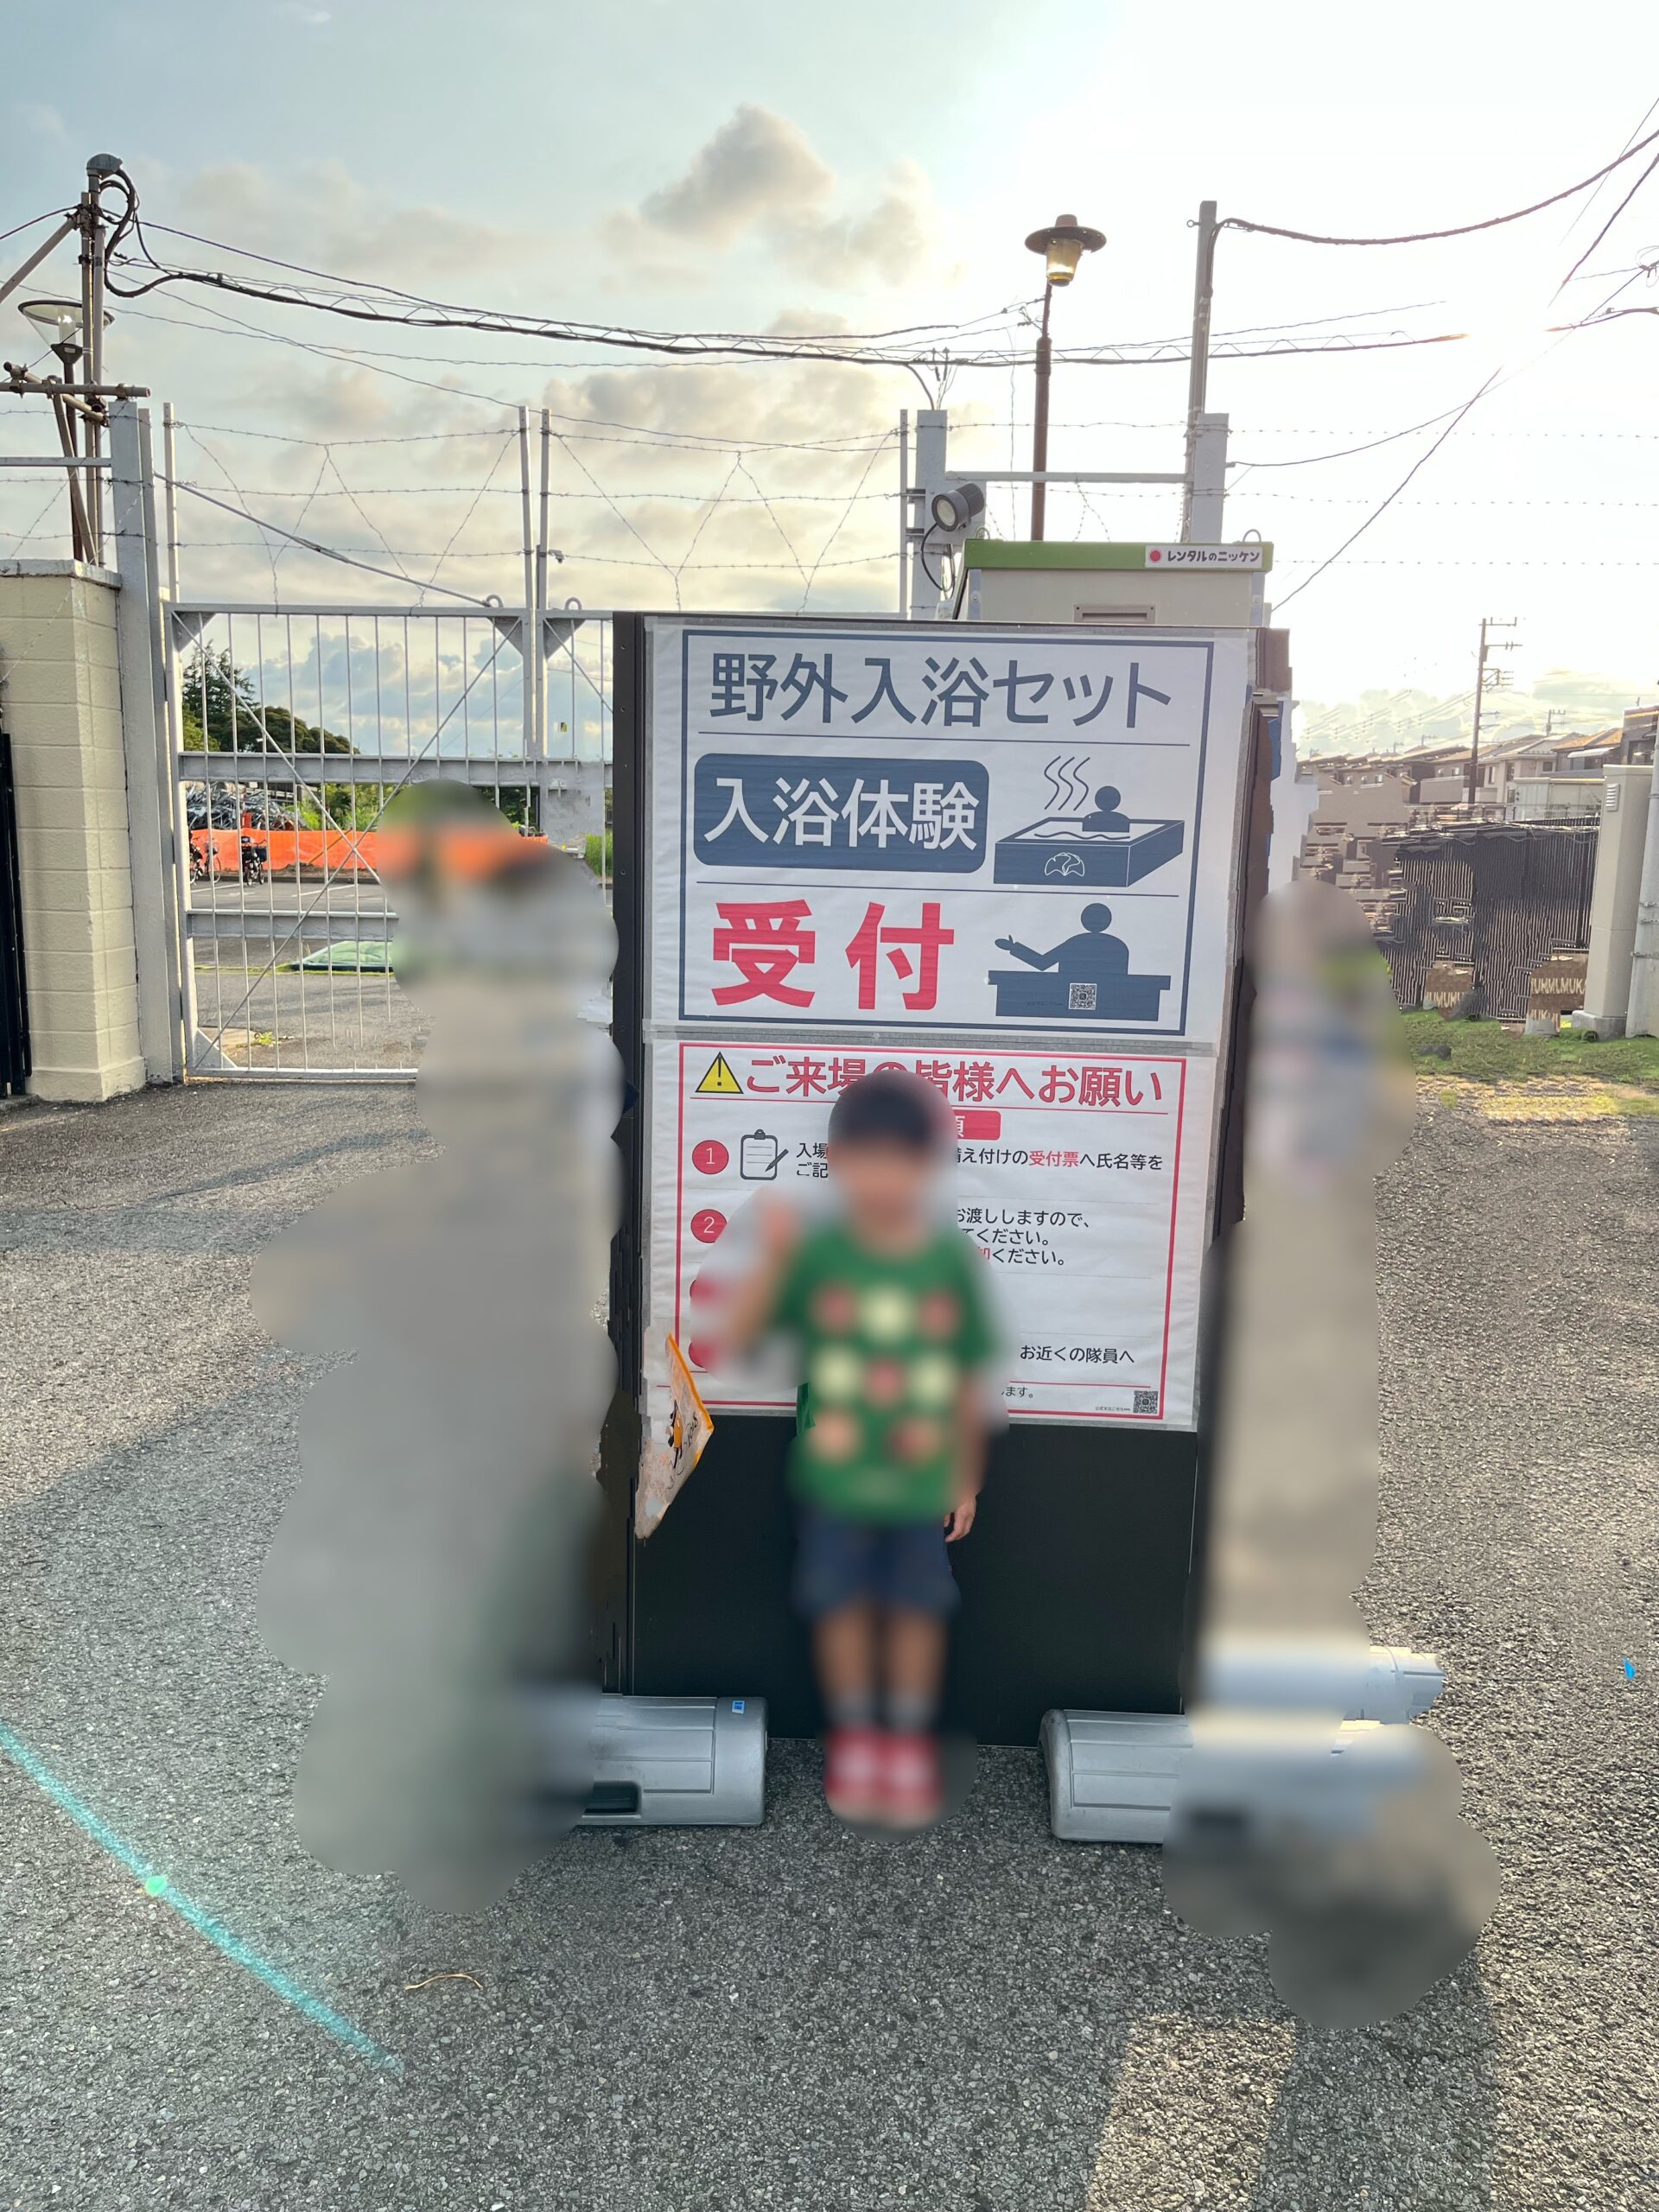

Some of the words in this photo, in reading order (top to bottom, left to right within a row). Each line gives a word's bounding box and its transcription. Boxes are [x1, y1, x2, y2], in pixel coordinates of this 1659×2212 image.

[1167, 550, 1260, 563] レンタルのニッケン
[709, 652, 1172, 729] 野外入浴セット
[703, 777, 981, 851] 入浴体験
[711, 899, 955, 1011] 受付
[957, 1147, 1163, 1171] え付けの受付票へ氏名等を
[1020, 1344, 1135, 1364] お近くの隊員へ
[1001, 1385, 1033, 1398] ます。
